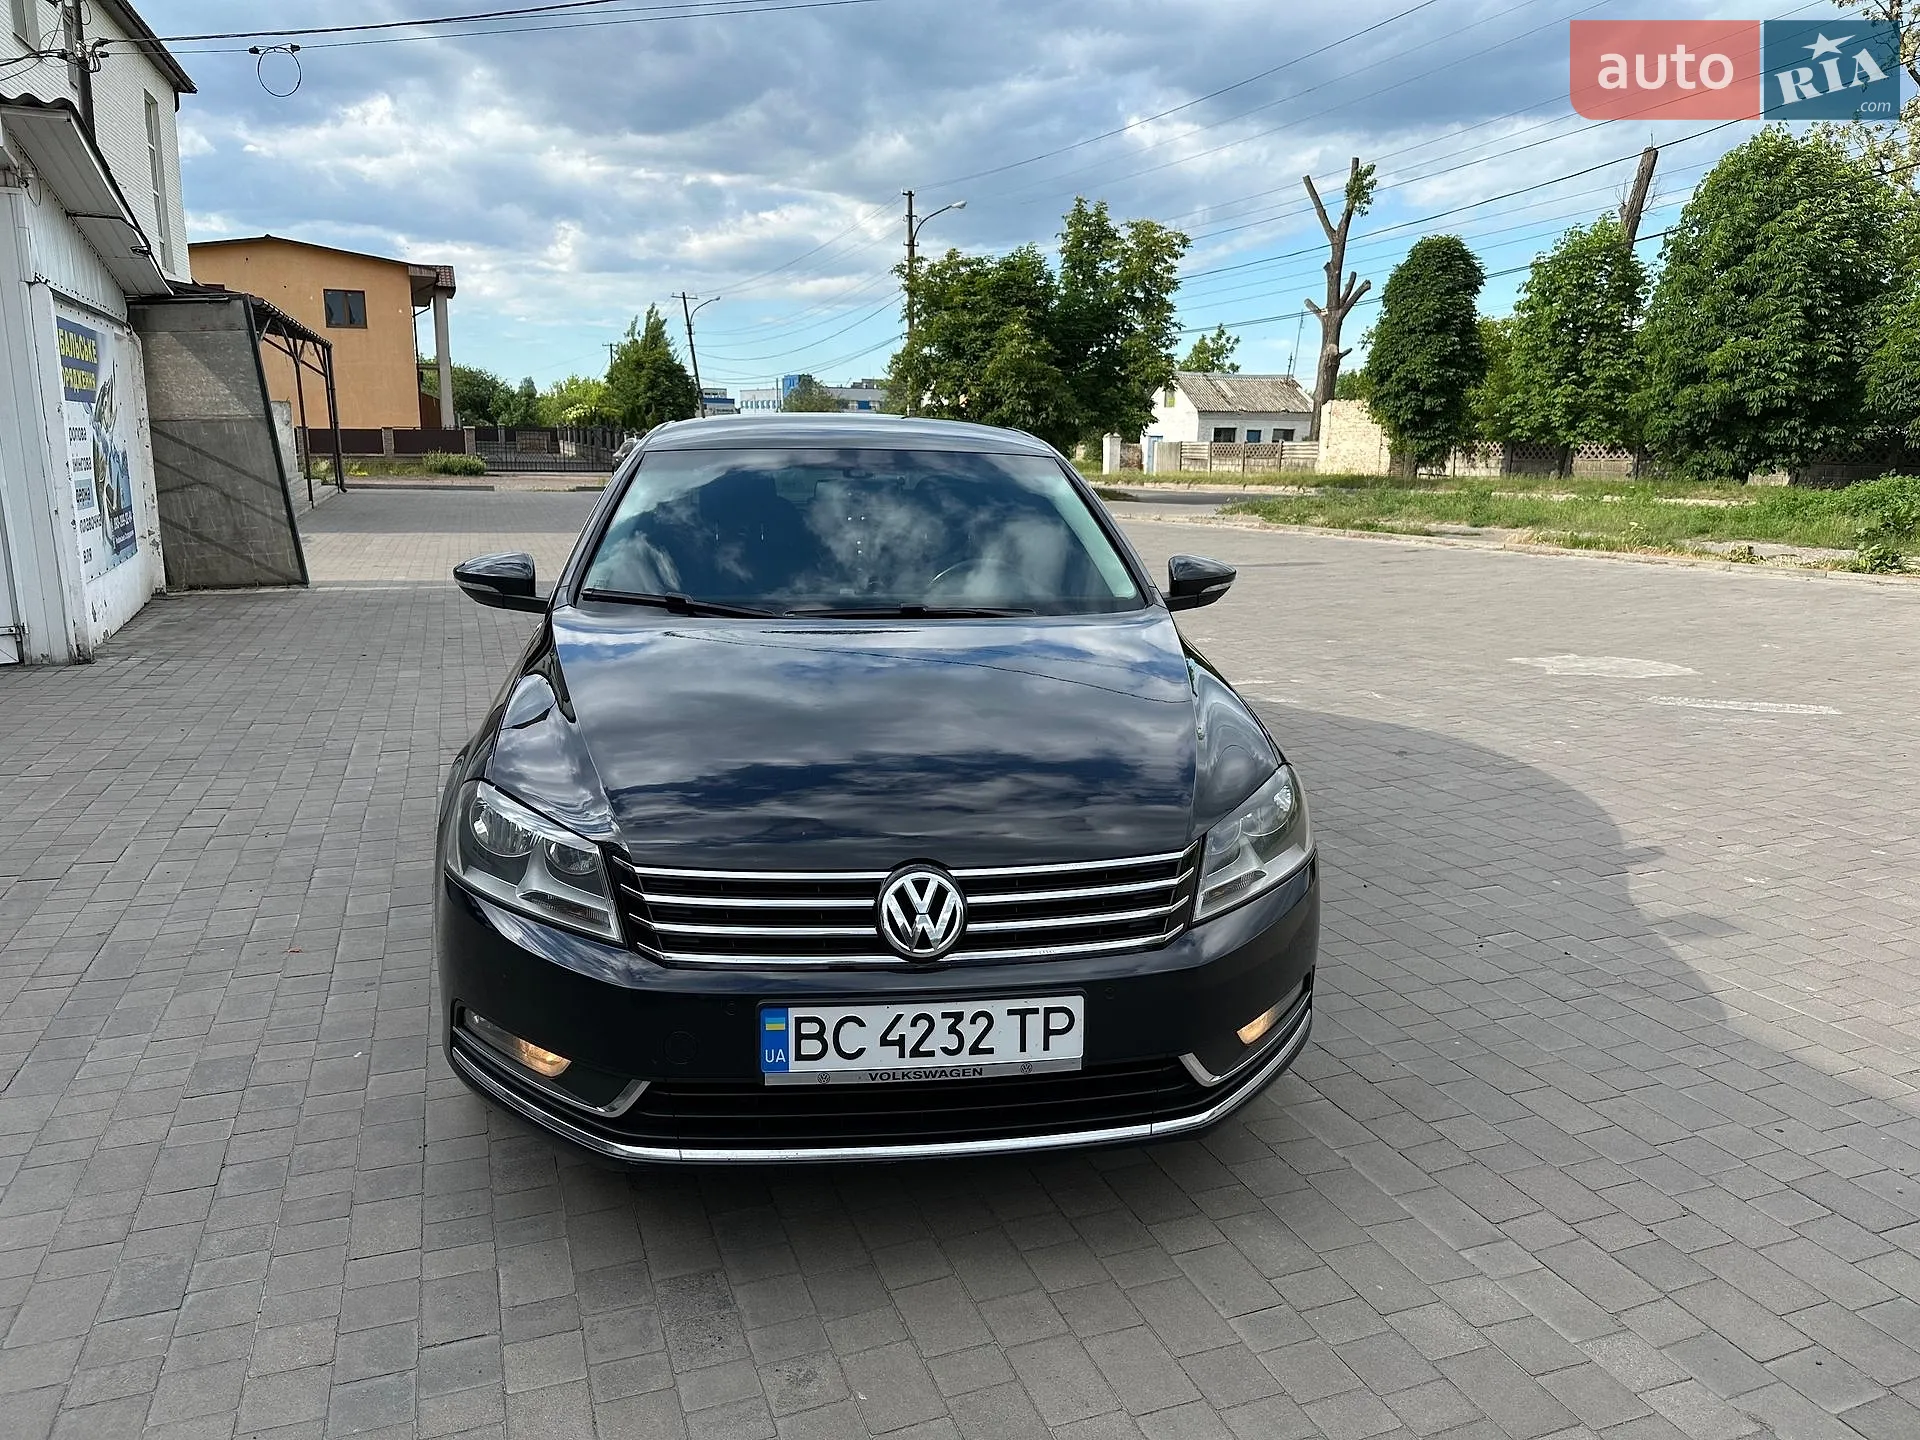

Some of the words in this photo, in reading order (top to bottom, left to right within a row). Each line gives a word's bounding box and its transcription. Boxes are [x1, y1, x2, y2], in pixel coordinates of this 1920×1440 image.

[794, 1013, 867, 1062] BC
[879, 1010, 995, 1059] 4232
[1006, 1005, 1075, 1053] TP
[765, 1049, 786, 1063] UA
[868, 1067, 983, 1082] VOLKSWAGEN
